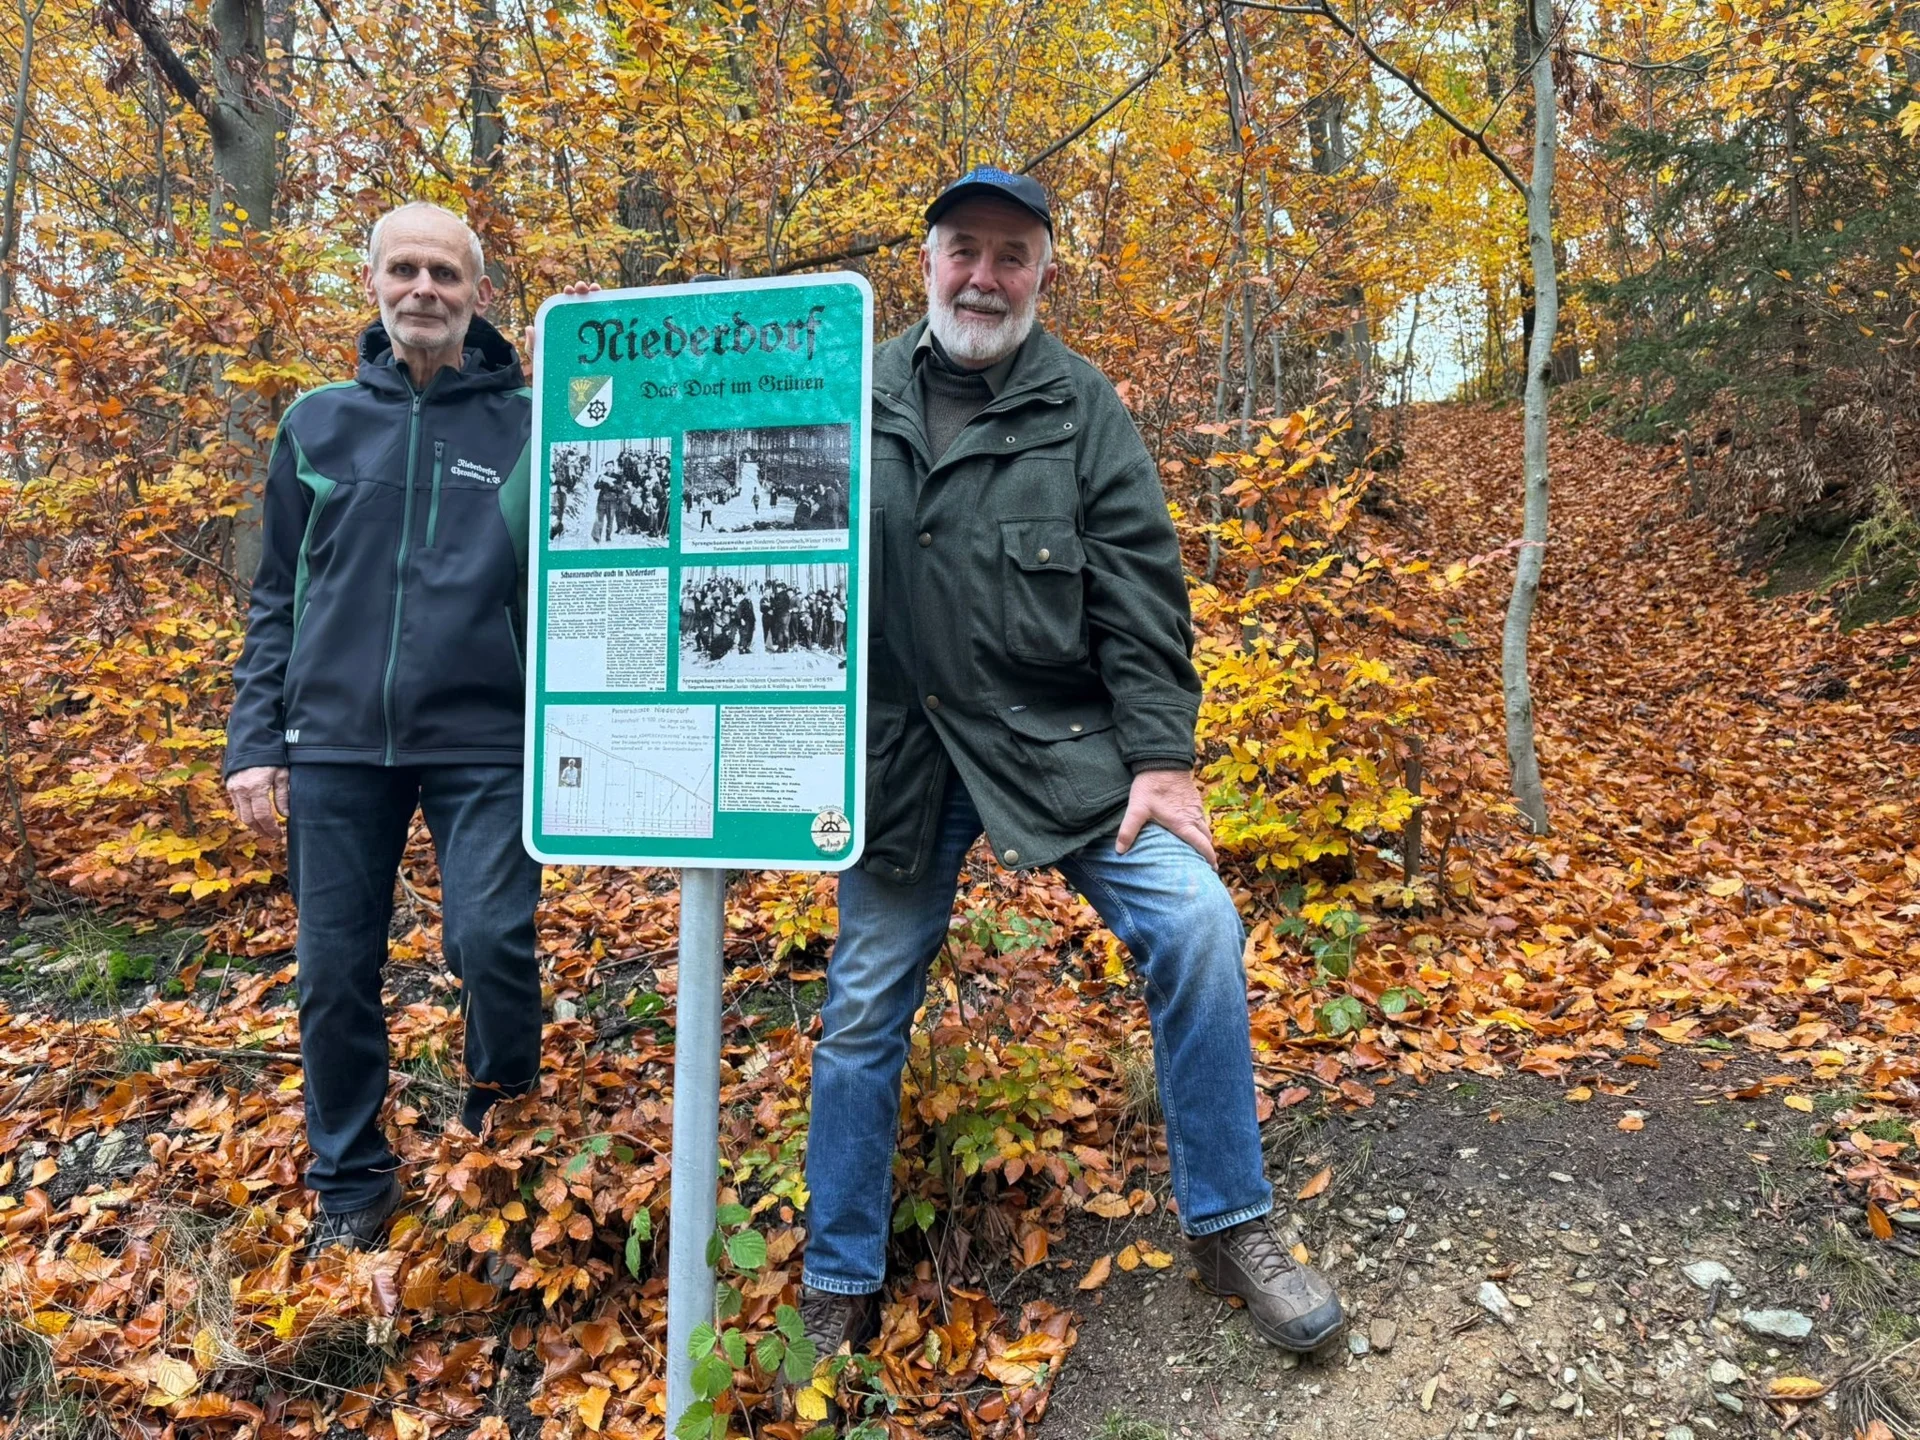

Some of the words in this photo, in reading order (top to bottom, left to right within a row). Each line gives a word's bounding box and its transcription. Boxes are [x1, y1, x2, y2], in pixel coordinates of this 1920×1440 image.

[578, 306, 825, 365] Niederdorf
[641, 380, 679, 399] Das
[684, 378, 724, 398] Dorf
[731, 380, 751, 394] im
[758, 374, 824, 392] Grünen
[450, 466, 485, 482] Chronisten
[458, 458, 497, 476] Niederdorfer
[561, 570, 602, 578] Schanzenweihe
[604, 570, 616, 578] auch
[617, 569, 624, 577] in
[625, 568, 656, 577] Niederdorf
